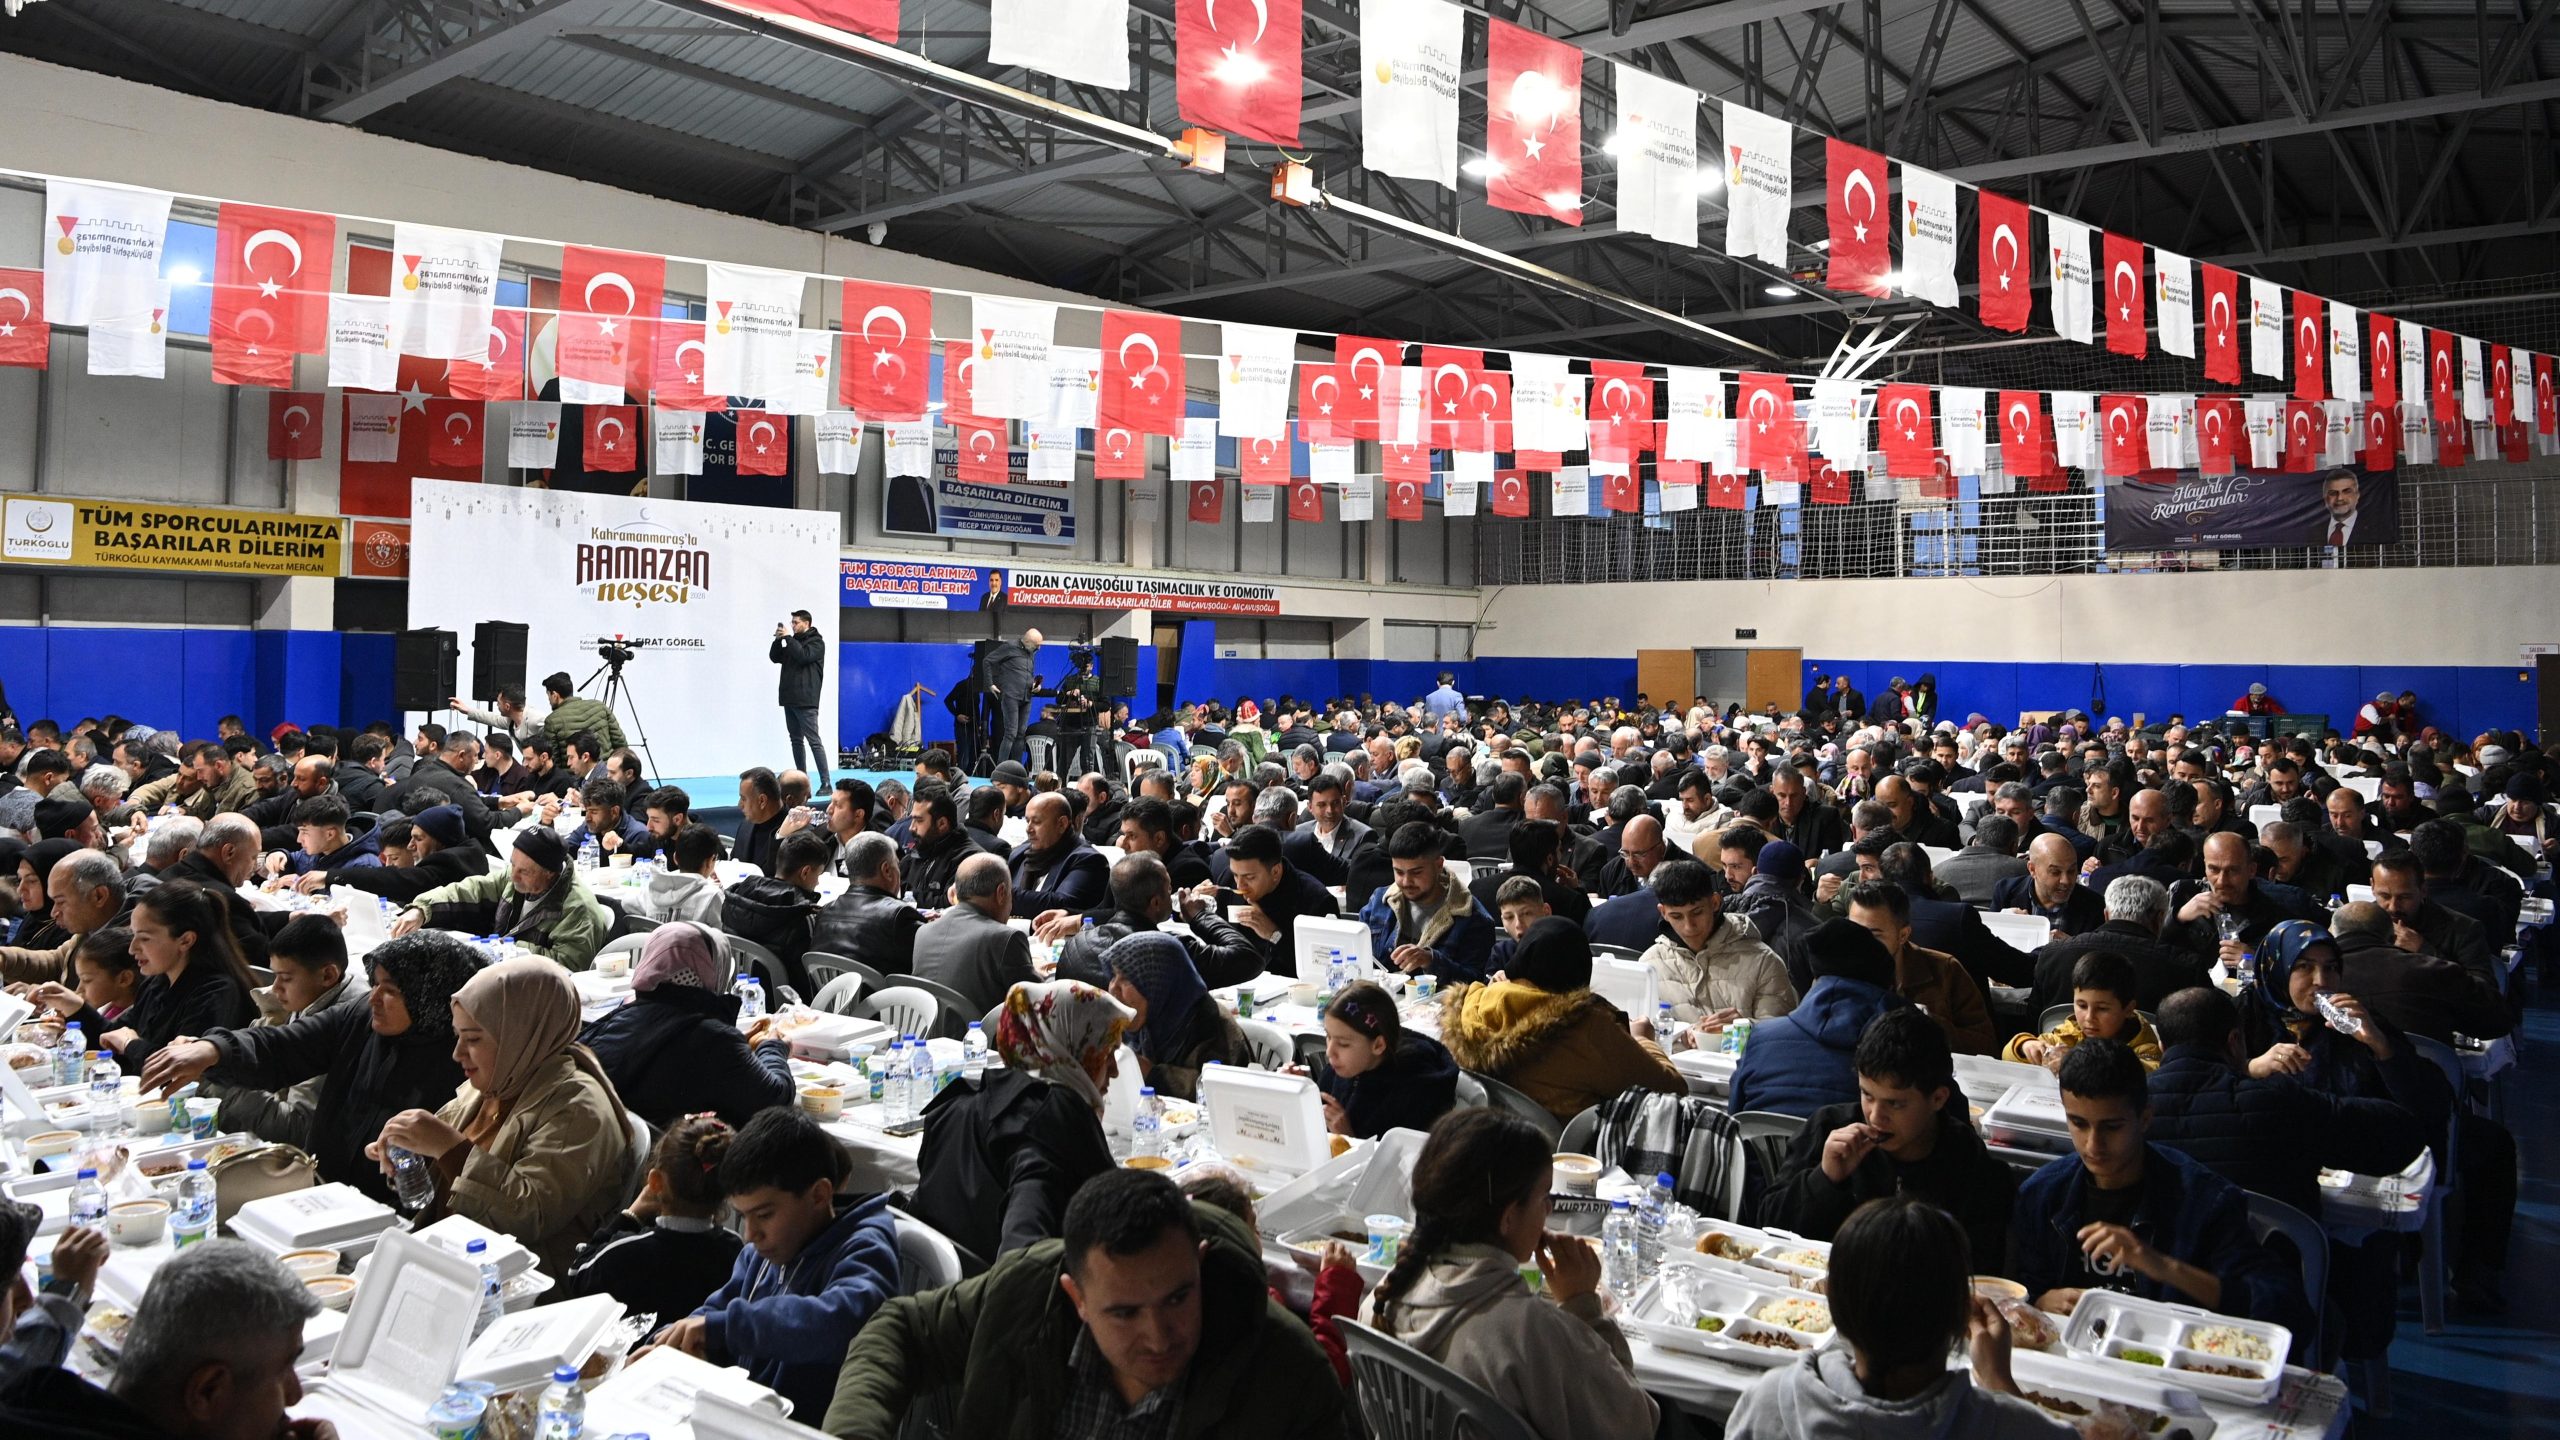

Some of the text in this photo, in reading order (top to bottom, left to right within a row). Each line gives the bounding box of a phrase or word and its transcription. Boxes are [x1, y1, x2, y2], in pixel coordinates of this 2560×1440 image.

[703, 453, 725, 464] POR
[946, 484, 1063, 510] BAŞARILAR DİLERİM.
[2151, 486, 2252, 519] Ramazanlar
[80, 506, 339, 540] TÜM SPORCULARIMIZA
[969, 511, 1022, 521] CUMHURBAŞKANI
[958, 521, 1032, 534] RECEP TAYYİP ERDOĞAN
[95, 531, 324, 558] BAŞARILAR DİLERİM
[96, 552, 323, 572] TÜRKOĞLU KAYMAKAMI Mustafa Nevzat MERCAN
[577, 544, 709, 590] RAMAZAN
[840, 563, 977, 580] TÜM SPORCULARIMIZA
[597, 577, 689, 608] neşesi
[846, 577, 918, 593] BAŞARILAR
[1016, 574, 1274, 600] DURAN ÇAVUŞOĞLU TAŞIMACILIK VE OTOMOTİV
[1013, 590, 1172, 609] TÜM SPORCULARIMIZA BAŞARILAR DİLER
[1191, 601, 1228, 611] ÇAVUŞOĞLU
[1240, 603, 1275, 612] ÇAVUŞOĞLU
[666, 637, 705, 647] GÖRGEL
